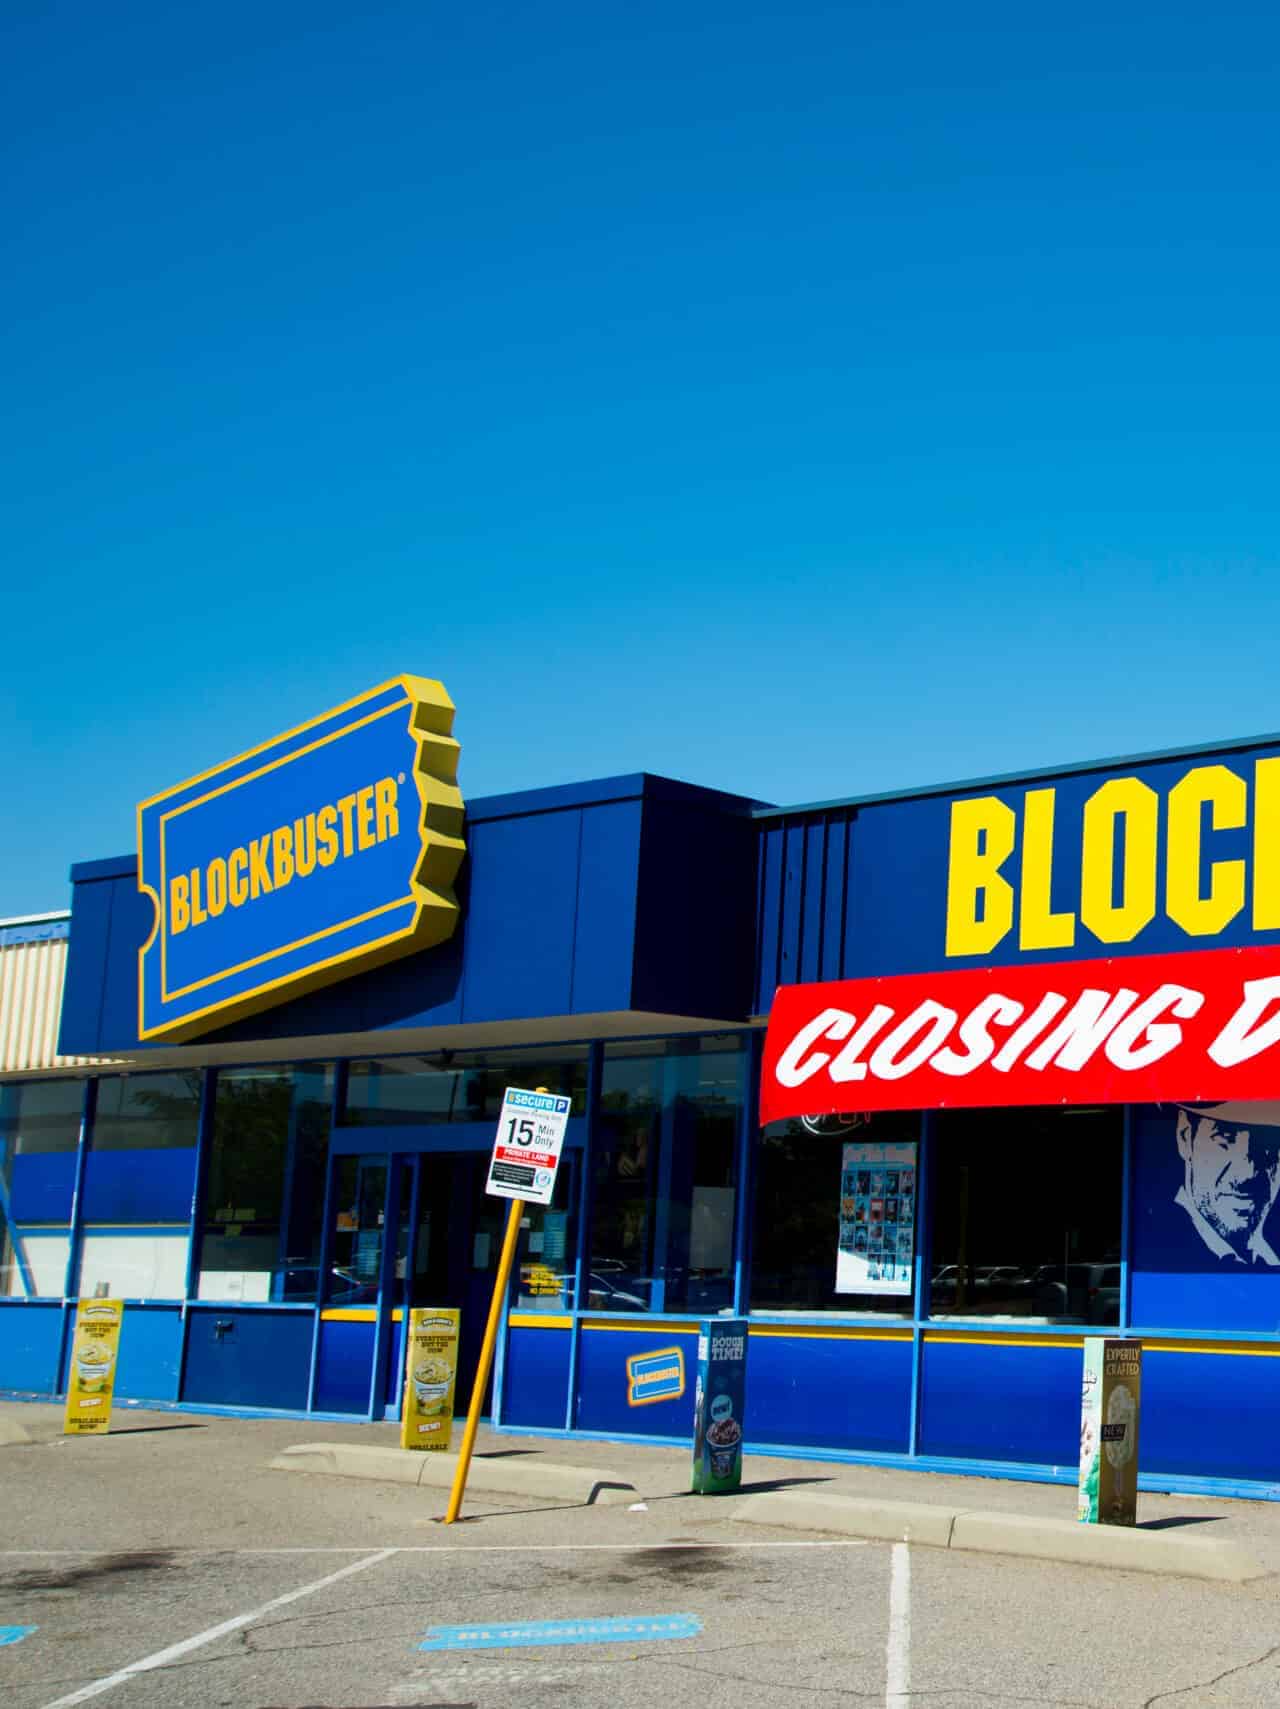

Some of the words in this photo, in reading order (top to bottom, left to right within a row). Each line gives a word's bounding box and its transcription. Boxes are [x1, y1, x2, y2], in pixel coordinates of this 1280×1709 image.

[170, 777, 399, 935] BLOCKBUSTER
[775, 984, 1205, 1088] CLOSING
[508, 1117, 535, 1146] 15
[538, 1124, 555, 1136] Min
[712, 1336, 744, 1348] DOUGH
[711, 1347, 744, 1361] TIME!
[1105, 1363, 1139, 1377] CRAFTED
